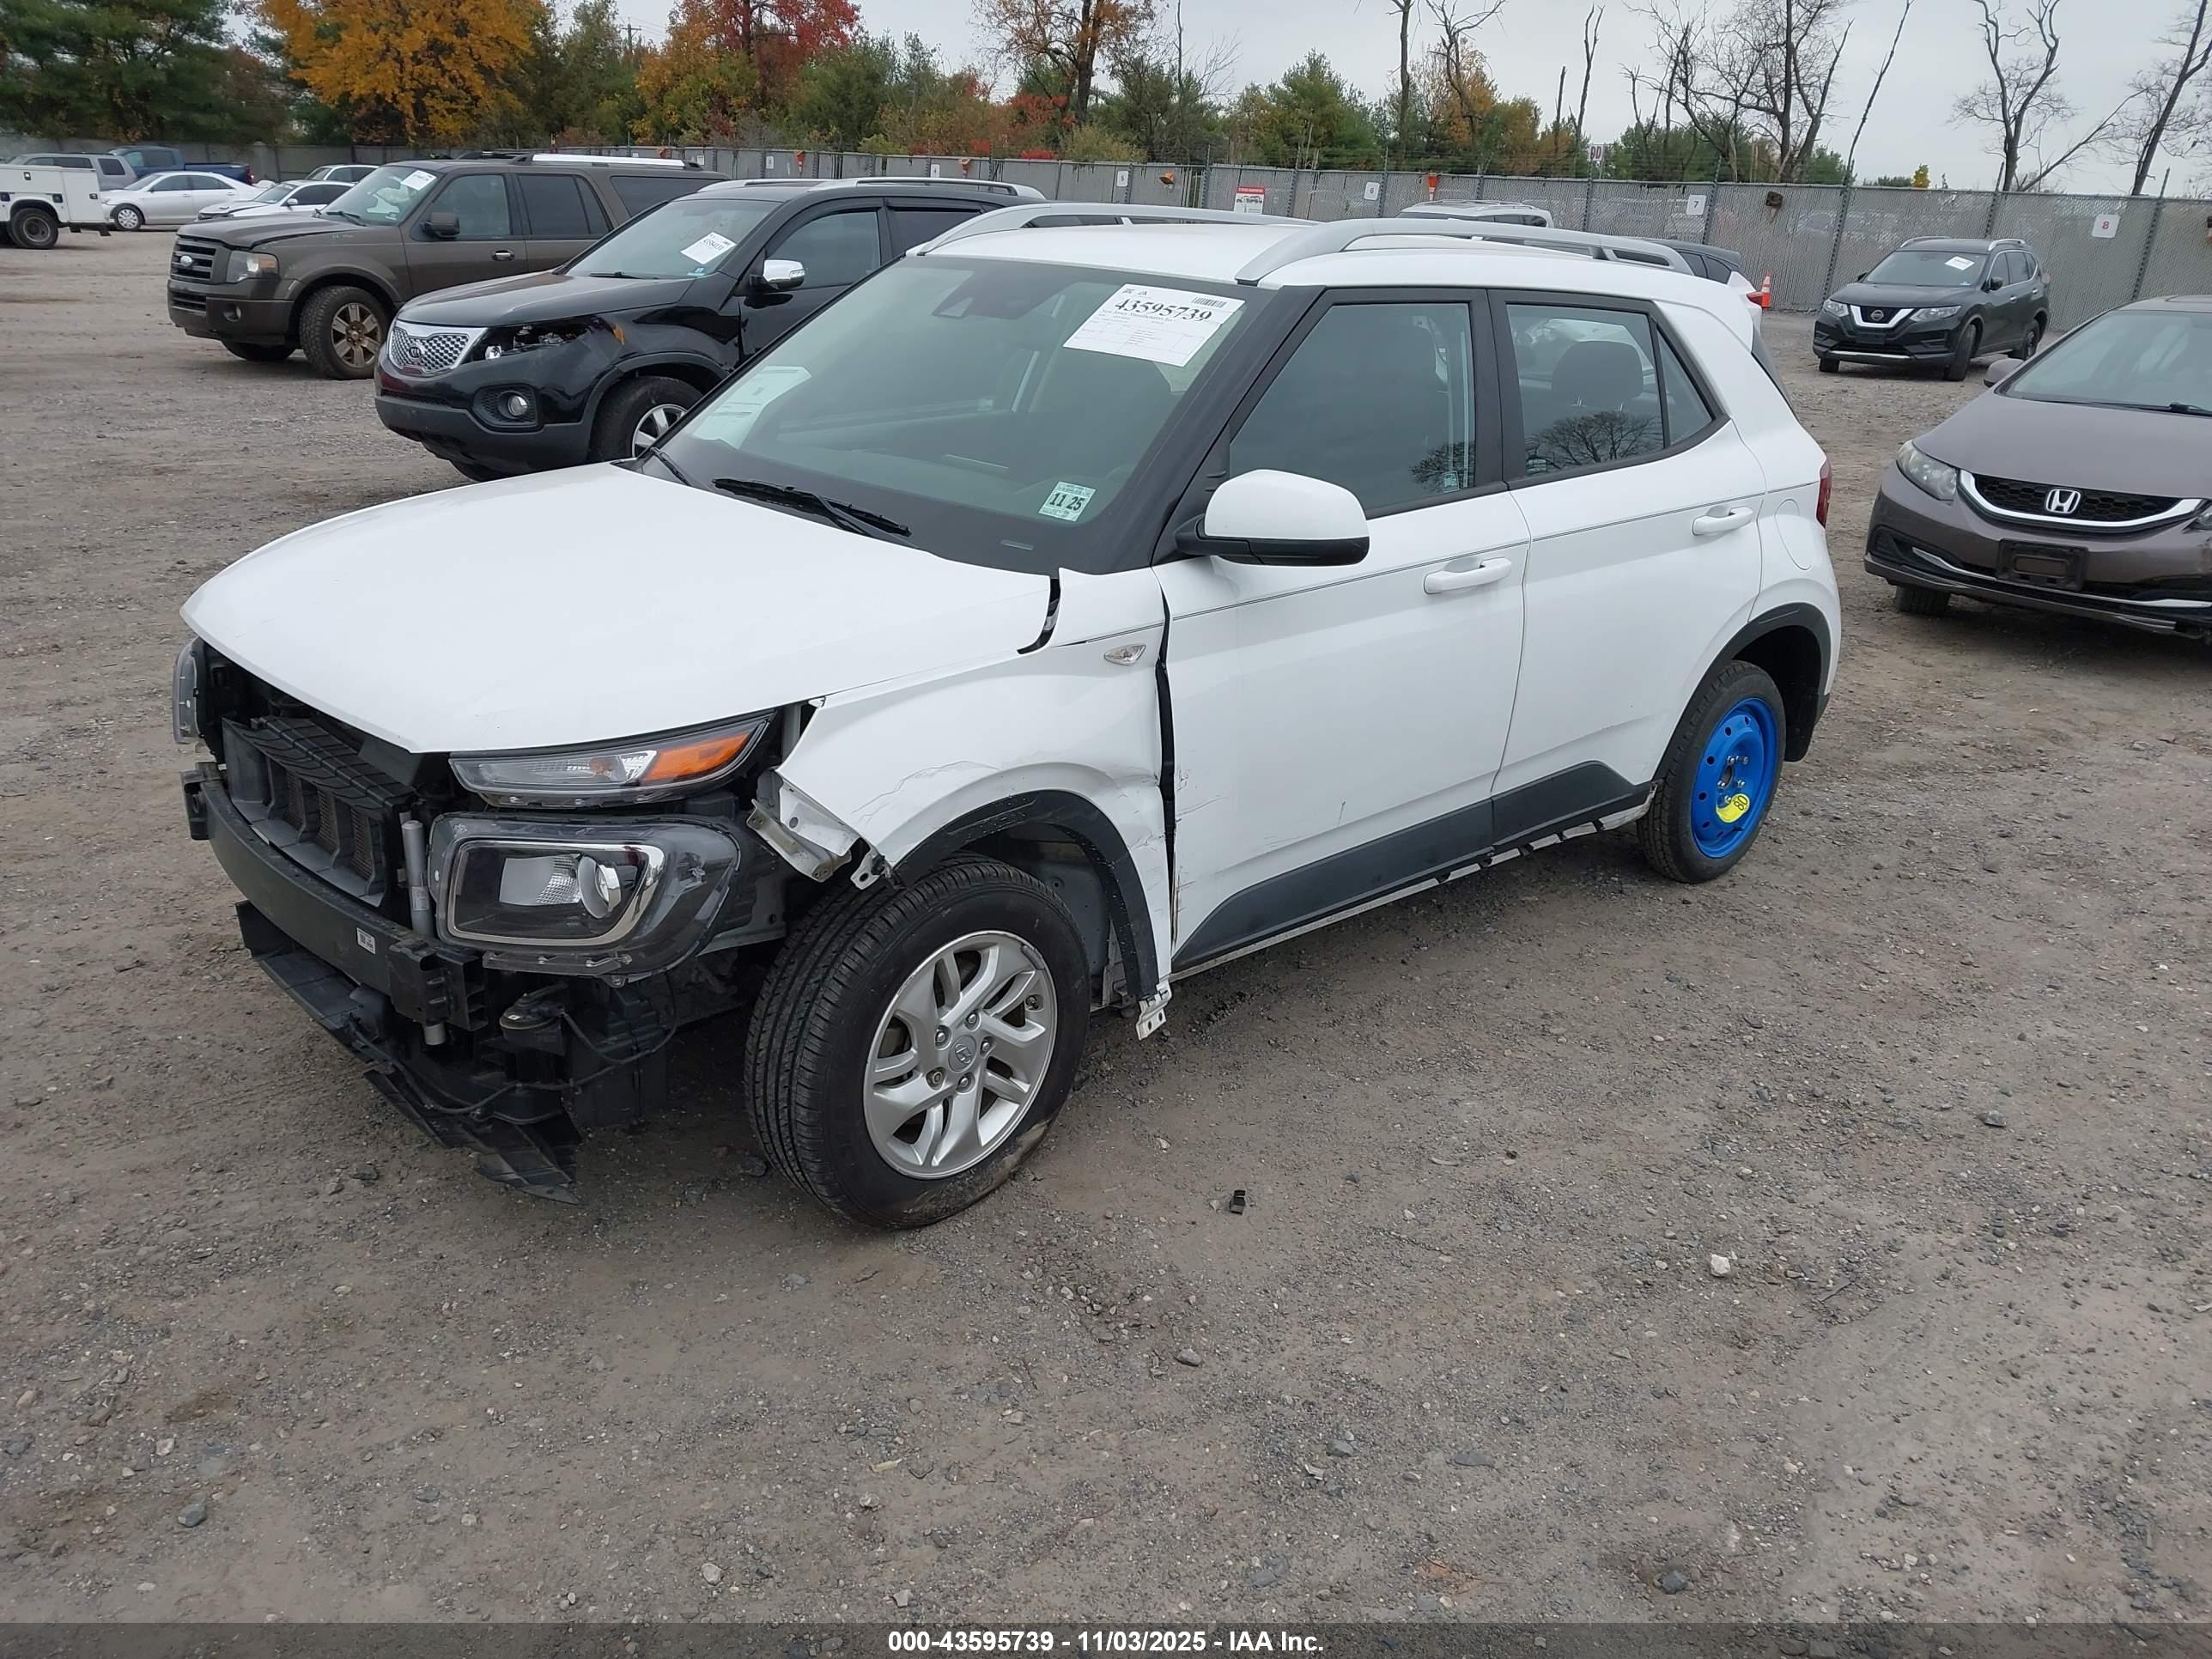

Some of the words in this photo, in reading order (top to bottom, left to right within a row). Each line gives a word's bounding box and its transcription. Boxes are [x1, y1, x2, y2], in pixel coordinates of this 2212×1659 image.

[1693, 200, 1699, 209] 7
[2101, 221, 2110, 229] 8
[1115, 299, 1213, 322] 43595739
[1049, 492, 1067, 507] 11
[1066, 495, 1086, 511] 25
[1734, 794, 1748, 811] 80
